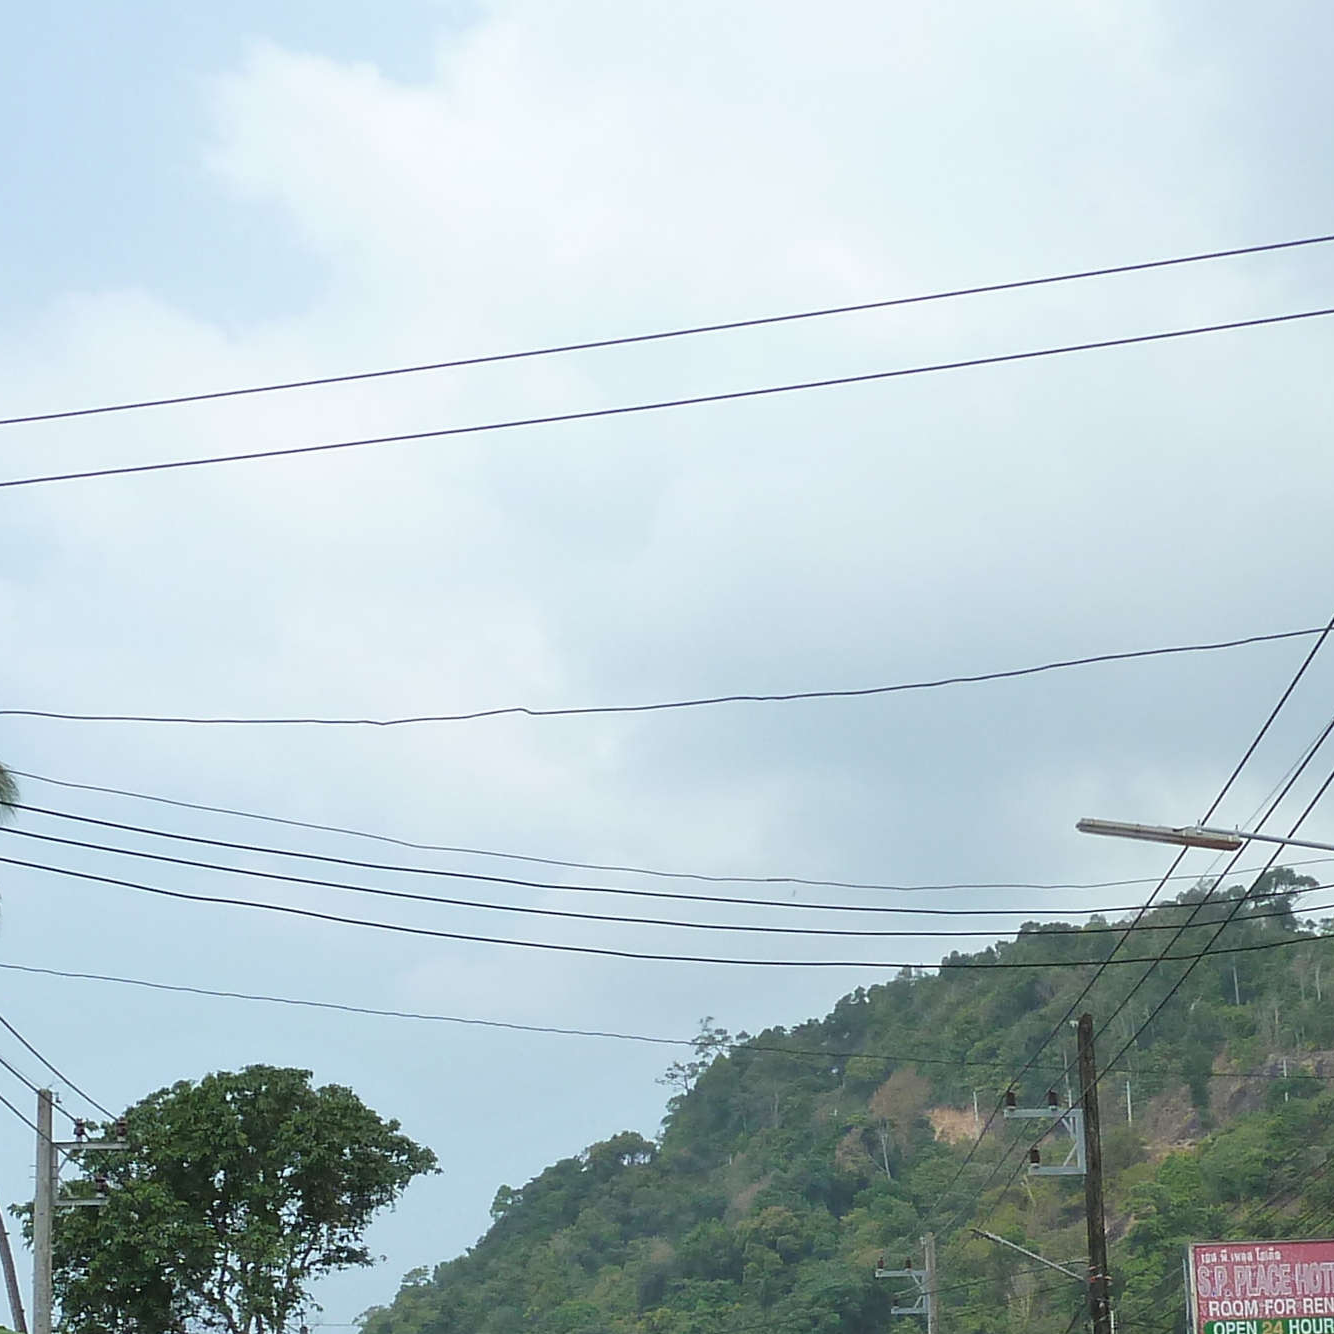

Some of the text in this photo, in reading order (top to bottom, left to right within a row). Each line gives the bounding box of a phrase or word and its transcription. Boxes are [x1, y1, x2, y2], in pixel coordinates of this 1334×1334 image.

[1234, 1263, 1293, 1297] PLACE
[1209, 1299, 1259, 1317] ROOM
[1265, 1299, 1297, 1315] FOR
